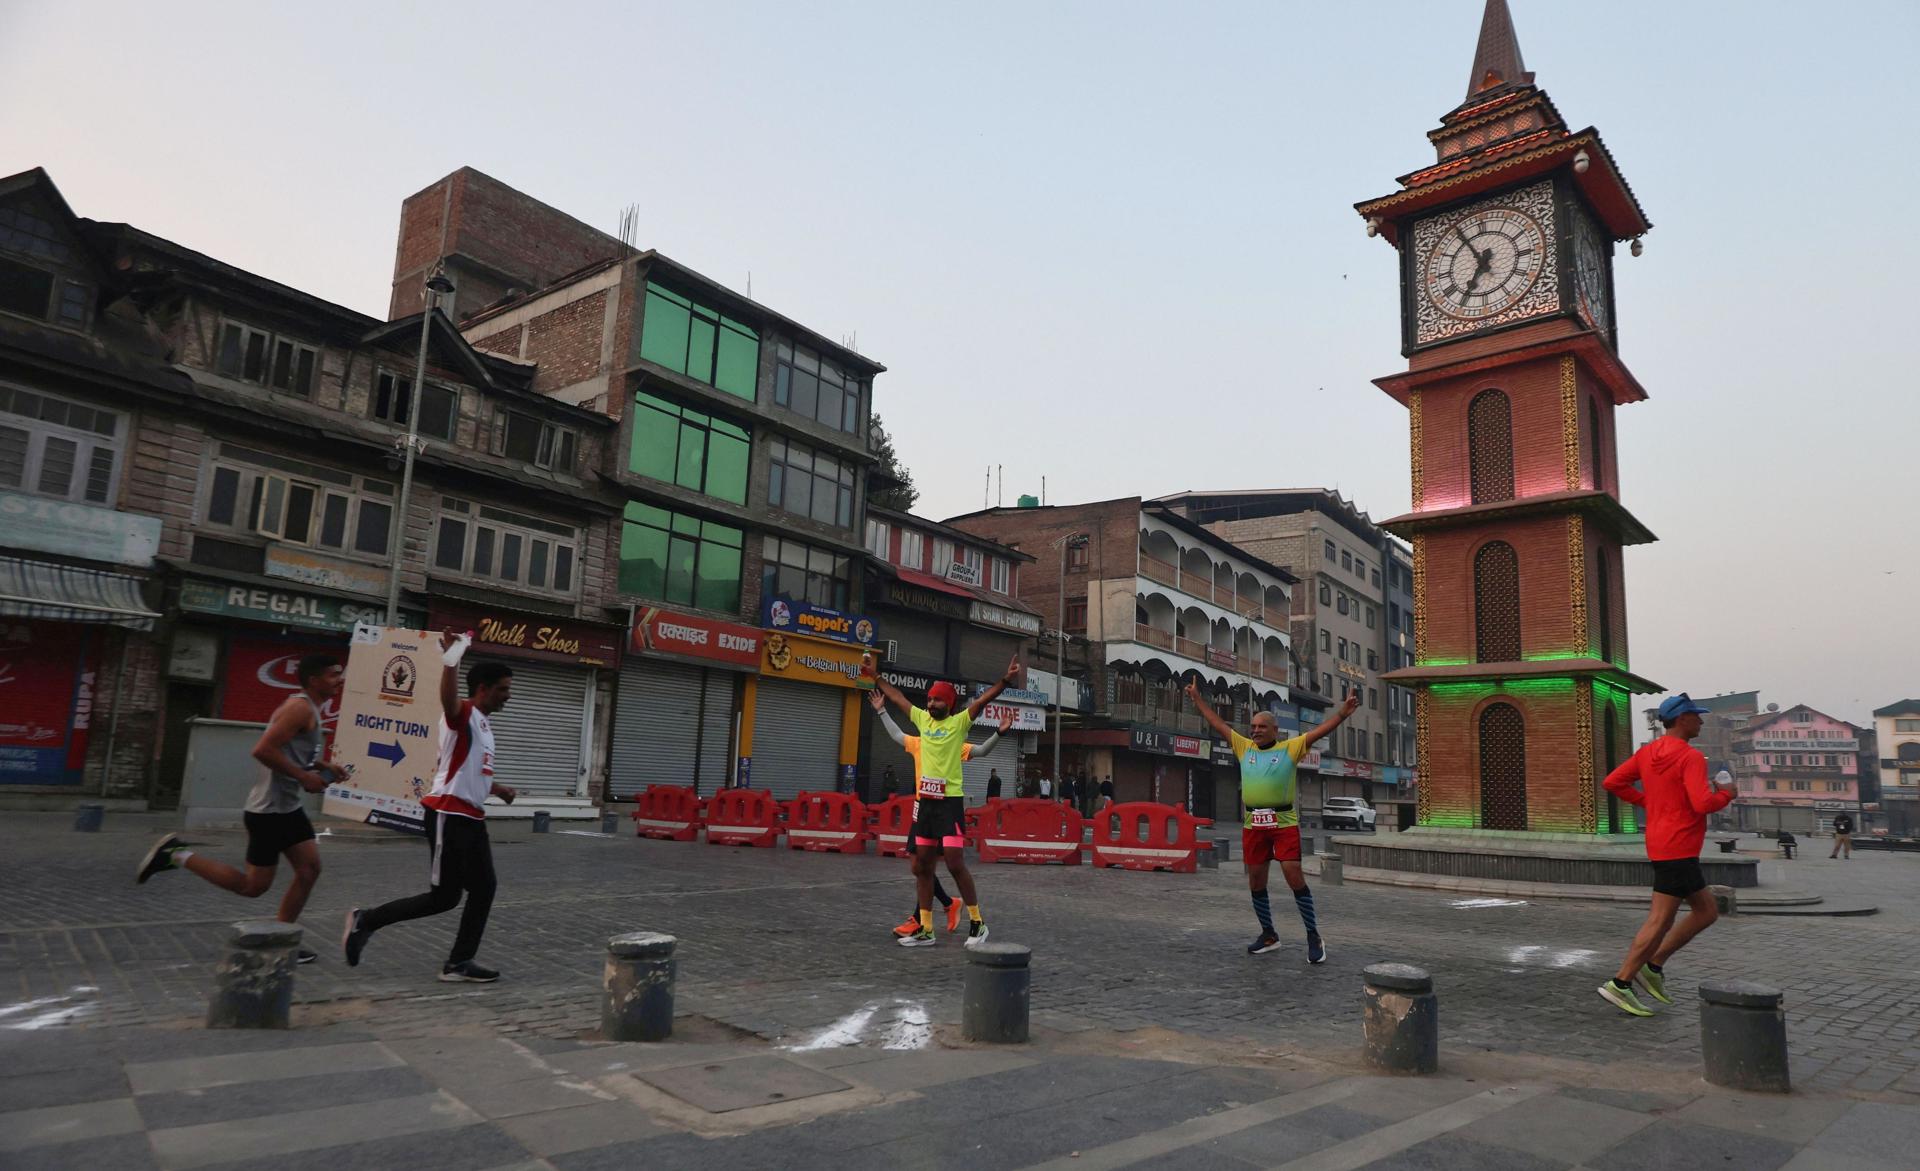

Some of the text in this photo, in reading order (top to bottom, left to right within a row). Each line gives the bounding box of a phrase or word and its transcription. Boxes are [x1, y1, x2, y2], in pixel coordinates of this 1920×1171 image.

[228, 586, 325, 619] REGAL
[478, 617, 580, 654] Walk Shoes
[718, 632, 757, 653] EXIDE
[807, 655, 838, 673] Belgian
[839, 660, 861, 679] Waffl
[881, 672, 928, 690] BOMBAY
[73, 671, 96, 729] RUPA
[355, 713, 430, 738] RIGHT TURN
[1136, 731, 1143, 744] U
[1176, 737, 1199, 750] LIBERTY
[921, 782, 942, 794] 1401
[1253, 813, 1274, 824] 1718
